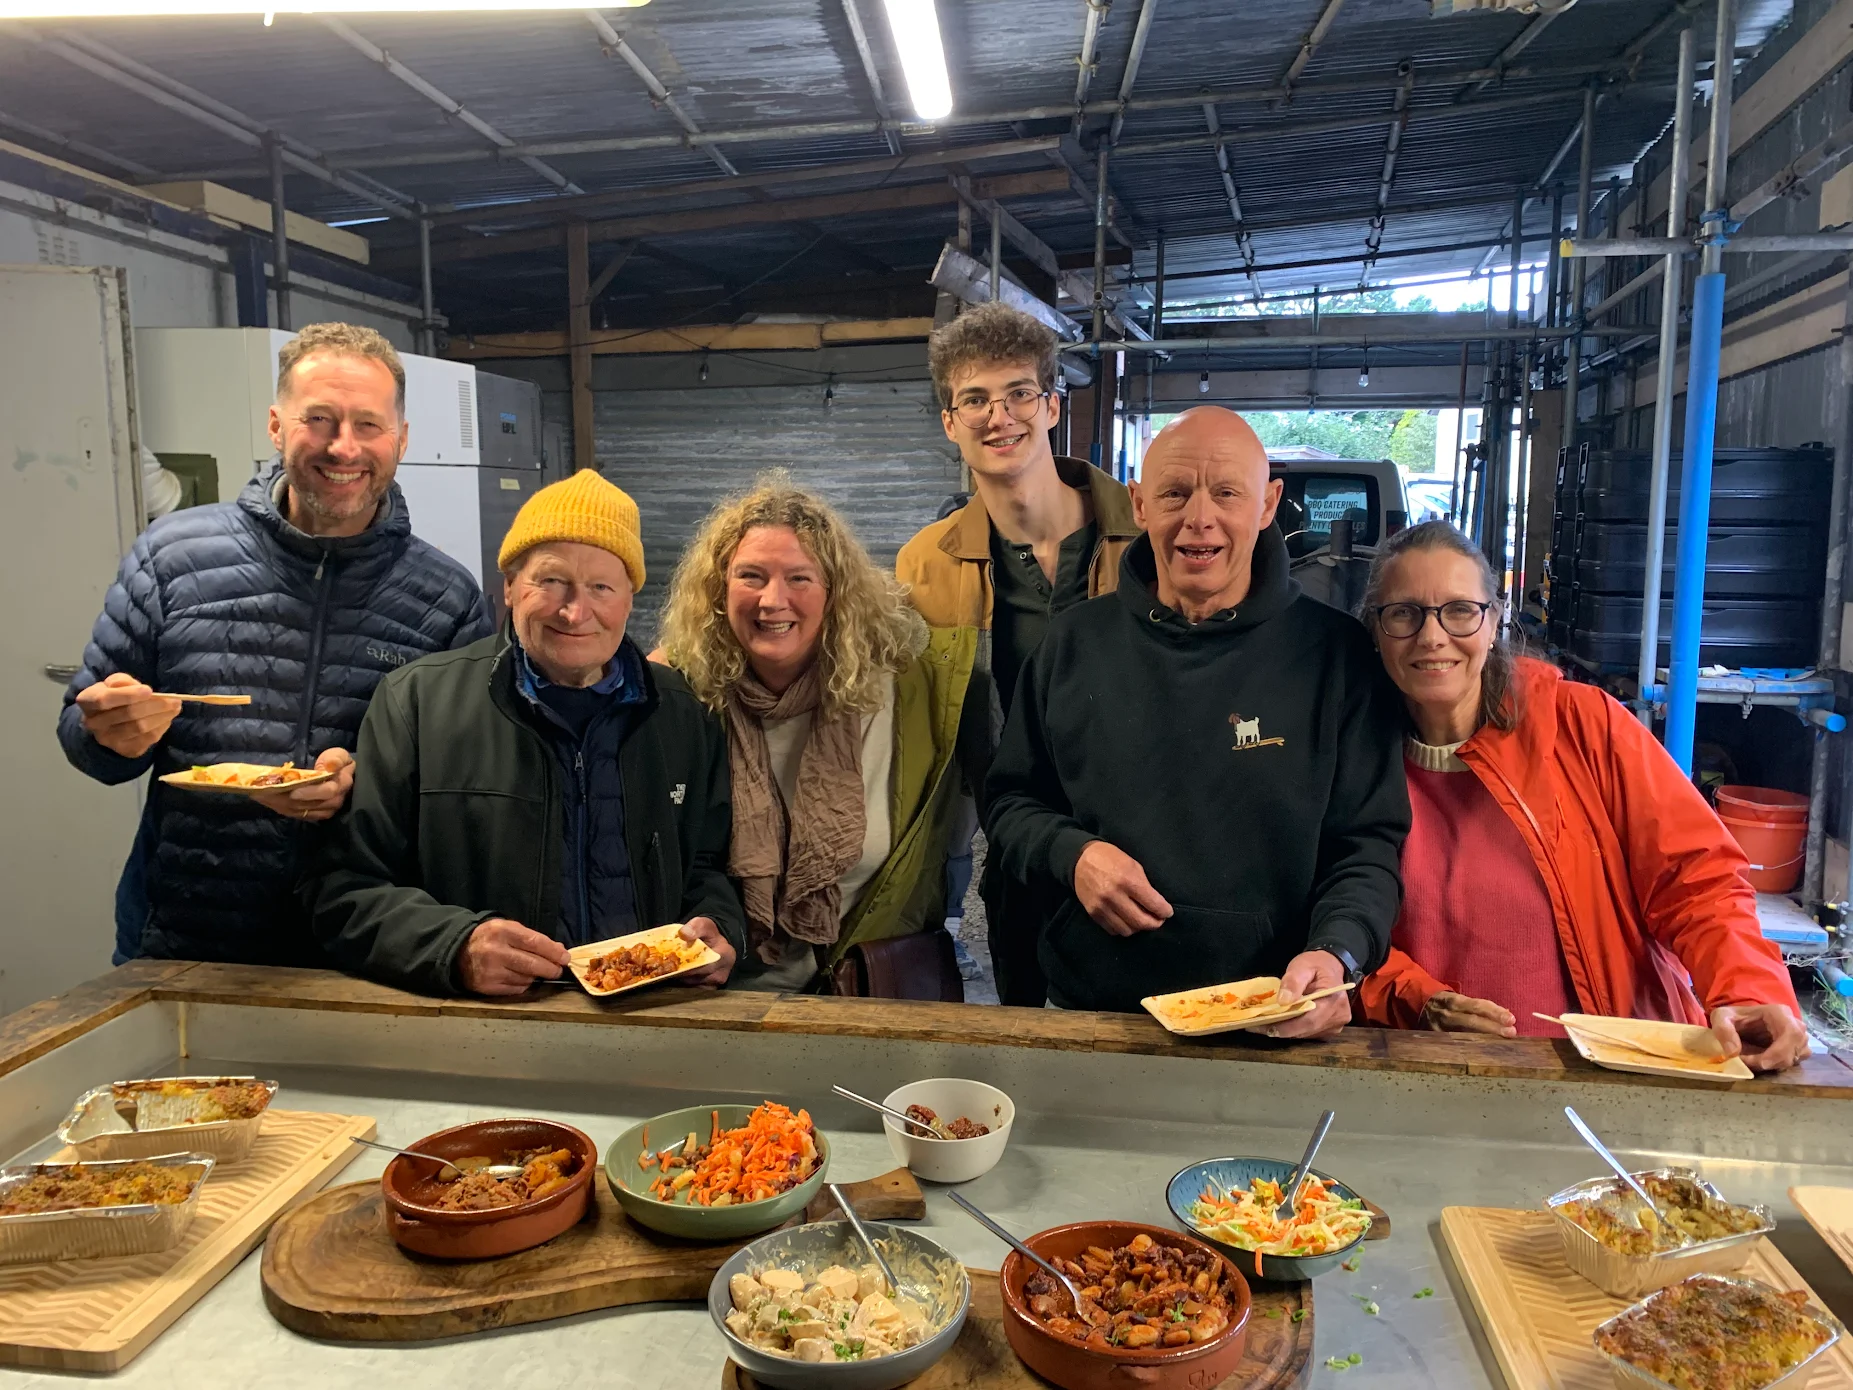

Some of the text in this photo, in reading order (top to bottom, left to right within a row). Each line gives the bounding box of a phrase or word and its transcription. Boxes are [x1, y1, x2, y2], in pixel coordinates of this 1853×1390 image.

[1308, 500, 1359, 510] BBQ CATERING
[1313, 510, 1347, 520] PRODUC
[1299, 521, 1327, 530] PENTY
[378, 648, 406, 665] Rab
